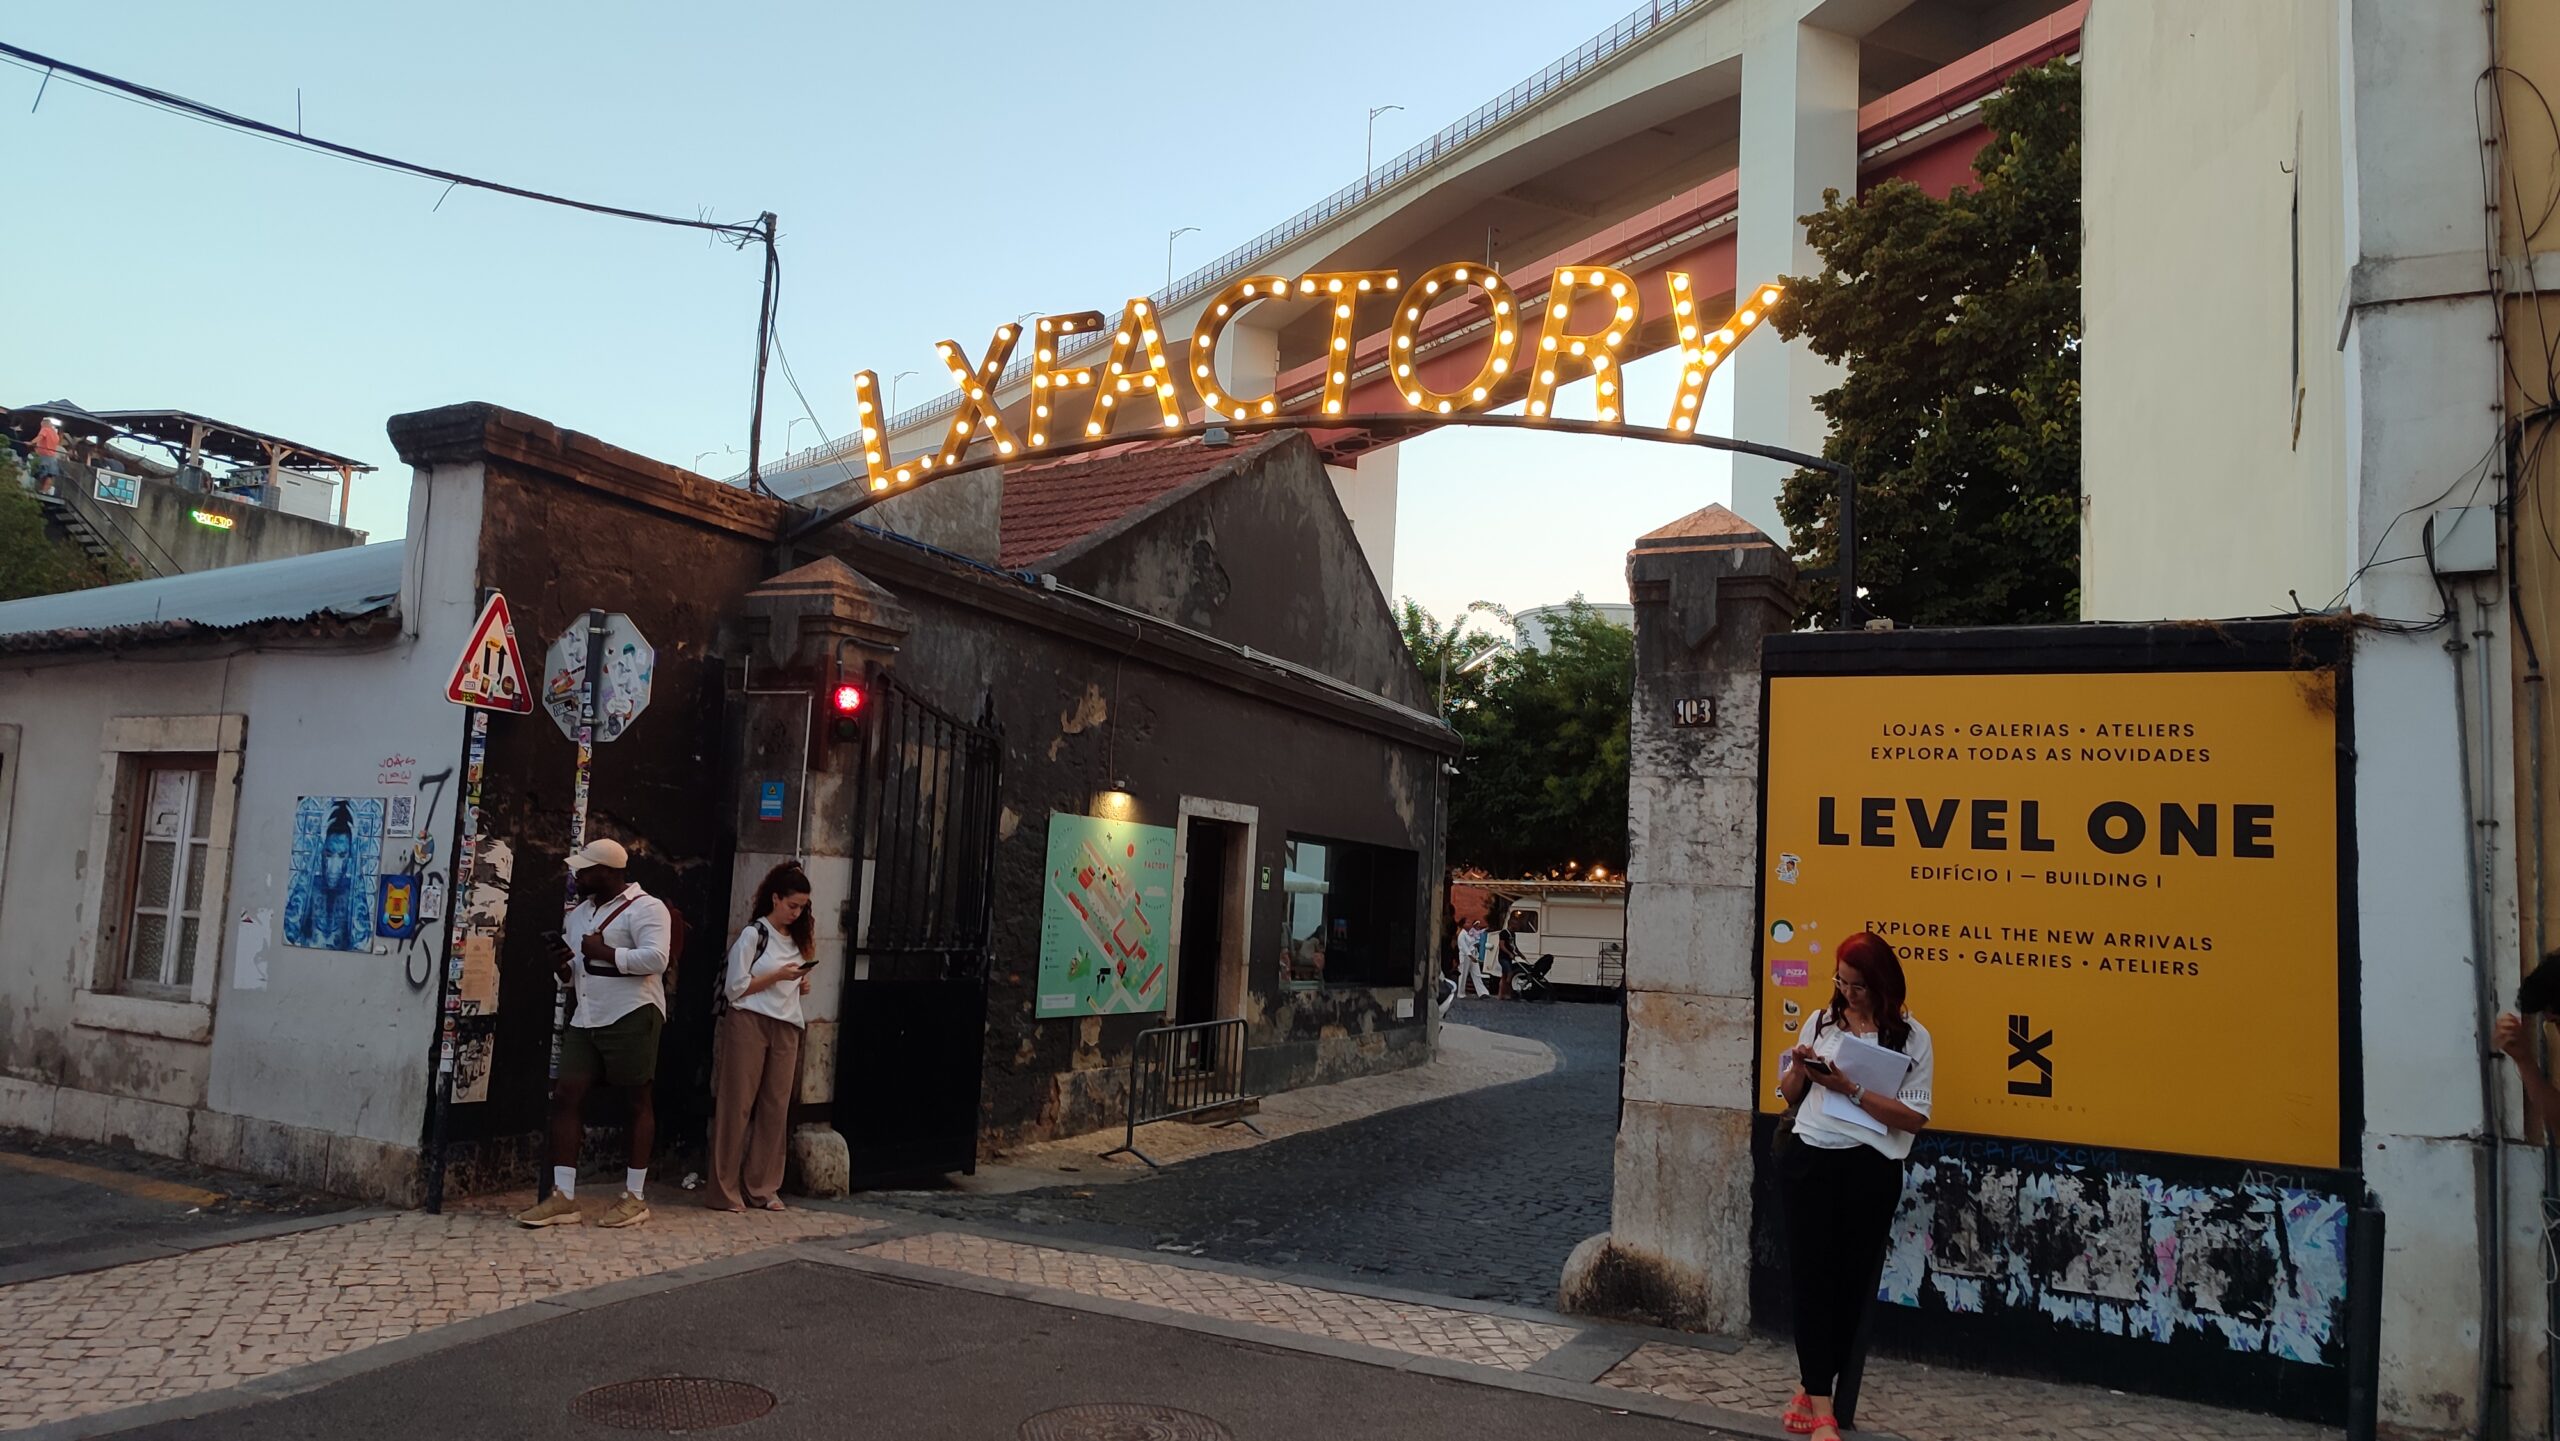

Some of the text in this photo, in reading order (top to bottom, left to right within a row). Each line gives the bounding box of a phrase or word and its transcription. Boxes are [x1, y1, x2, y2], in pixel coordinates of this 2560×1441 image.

[853, 262, 1785, 492] LXFACTORY
[1677, 699, 1711, 725] 103
[1884, 724, 2193, 737] LOJAS GALERIAS ATELIERS
[1872, 747, 2209, 762] EXPLORA TODAS AS NOVIDADES
[1819, 797, 2274, 858] LEVEL ONE
[1911, 864, 2161, 889] EDIFÍCIO I BUILDING I
[1865, 921, 2212, 951] EXPLORE ALL THE NEW ARRIVALS
[1975, 951, 2071, 968] GALERIES
[2100, 958, 2198, 976] ATELIERS
